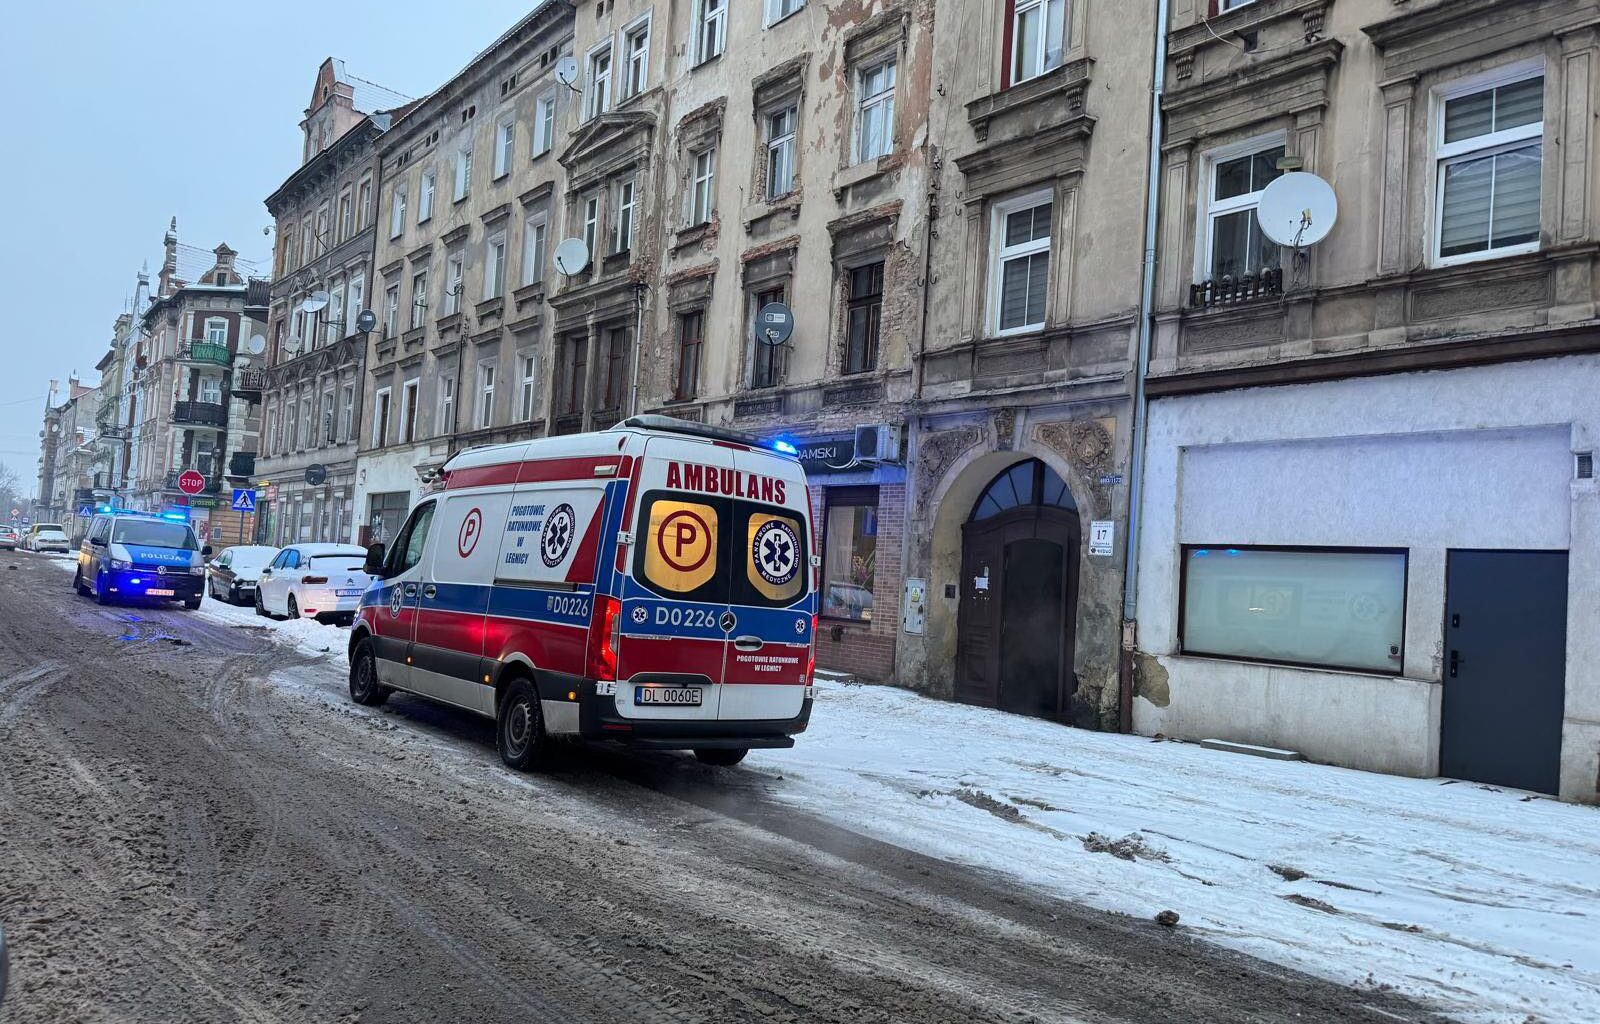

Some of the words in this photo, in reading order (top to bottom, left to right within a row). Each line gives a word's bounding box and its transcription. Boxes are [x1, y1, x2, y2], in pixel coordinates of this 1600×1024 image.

[181, 478, 203, 487] STOP
[666, 461, 786, 505] AMBULANS
[511, 504, 546, 516] POGOTOWIE
[507, 520, 542, 532] RATUNKOWE
[463, 519, 476, 547] P
[1096, 529, 1107, 540] 17
[517, 536, 524, 548] W
[675, 522, 697, 557] P
[141, 552, 182, 561] POLICJA
[505, 552, 529, 564] LEGNICY
[761, 572, 792, 584] MEDYCZNE
[553, 596, 588, 617] D0226
[655, 606, 716, 628] D0226
[736, 654, 768, 663] POGOTOWIE
[769, 656, 799, 664] RATUNKOWE
[761, 664, 782, 672] LEGNICY
[644, 688, 659, 702] DL
[664, 689, 699, 703] 0060E
